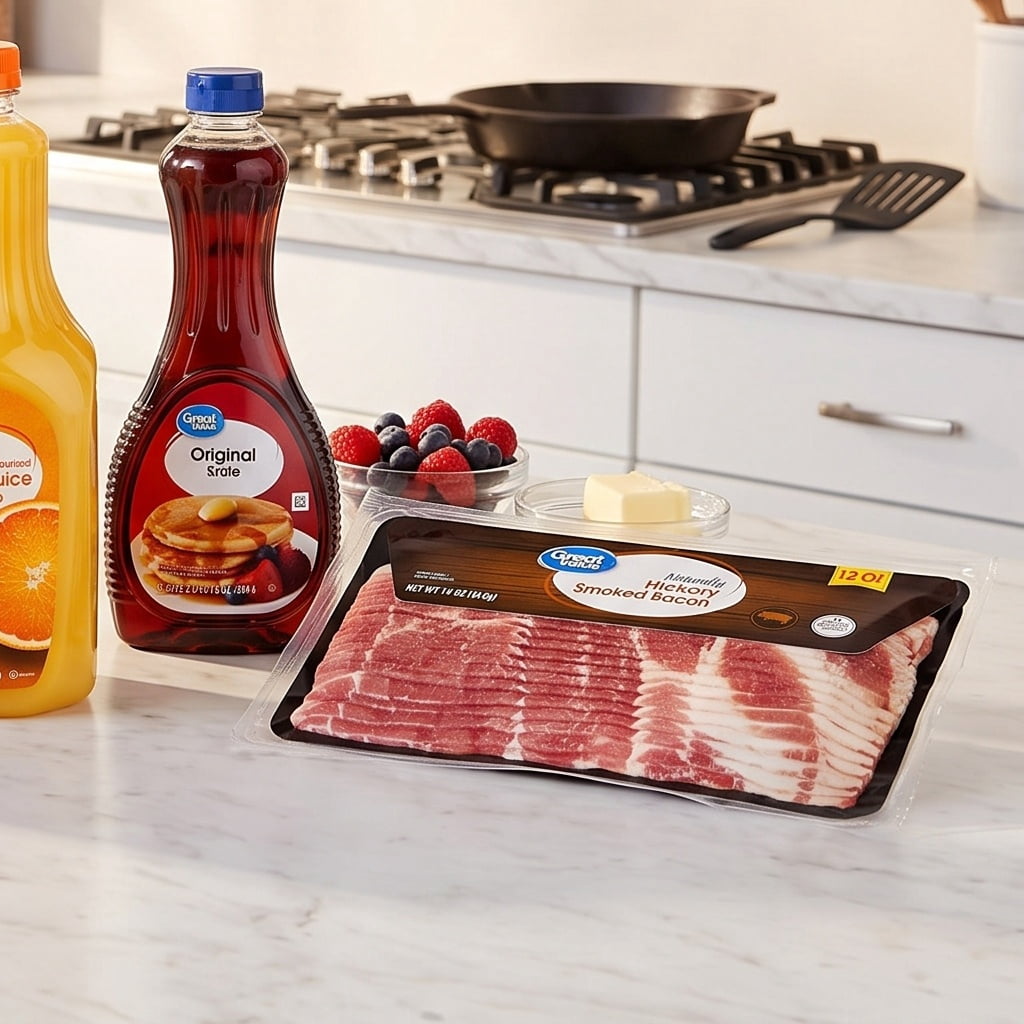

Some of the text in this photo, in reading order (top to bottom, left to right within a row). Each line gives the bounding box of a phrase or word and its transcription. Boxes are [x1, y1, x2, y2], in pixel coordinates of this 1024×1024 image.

[190, 447, 256, 465] Original
[838, 569, 858, 581] 12
[573, 582, 710, 608] Smoked Bacon
